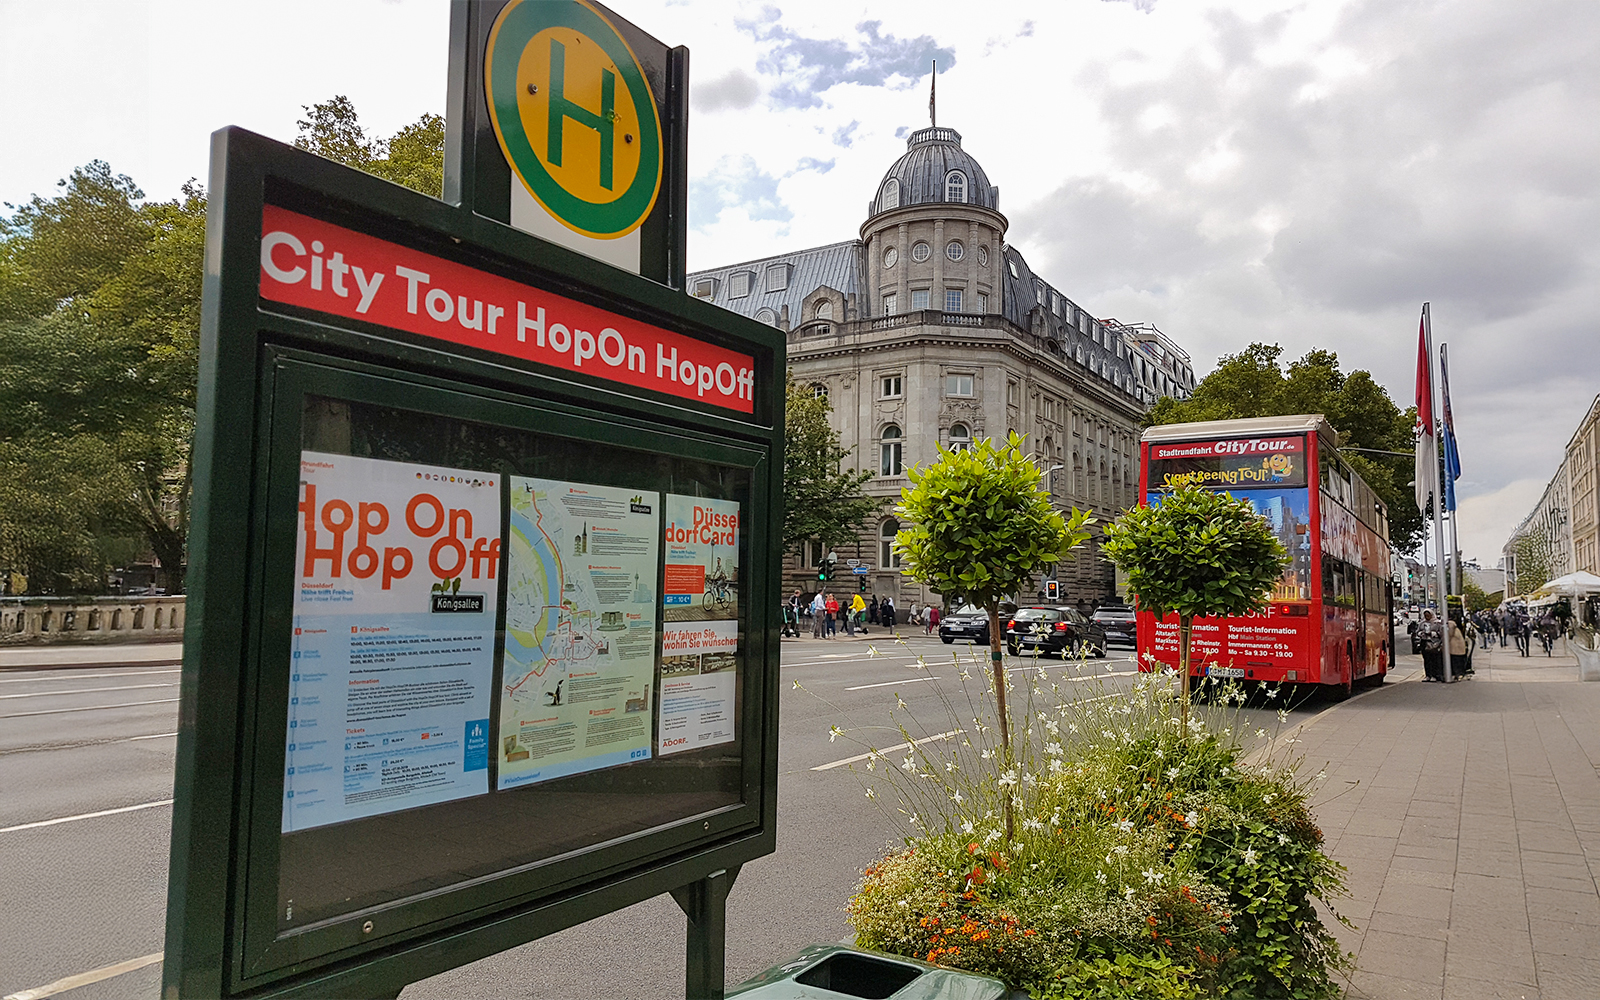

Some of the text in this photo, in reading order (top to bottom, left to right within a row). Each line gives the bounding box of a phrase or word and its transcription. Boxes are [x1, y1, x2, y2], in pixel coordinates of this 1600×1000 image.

[547, 38, 615, 191] H
[260, 231, 754, 401] City Tour HopOn HopOff
[1158, 446, 1212, 457] Stadtrundfahrt
[405, 493, 473, 539] On
[693, 506, 740, 528] Düssel
[665, 522, 735, 546] dorfCard
[303, 531, 500, 590] Hop Off
[437, 597, 480, 611] Königsallee
[1155, 622, 1219, 631] Tourist-rmation
[1228, 624, 1297, 635] Tourist-Information
[663, 631, 677, 641] Wir
[678, 629, 702, 641] fahren
[664, 640, 688, 650] wohin
[688, 639, 701, 648] Sie
[1228, 641, 1273, 649] Immermannstr.
